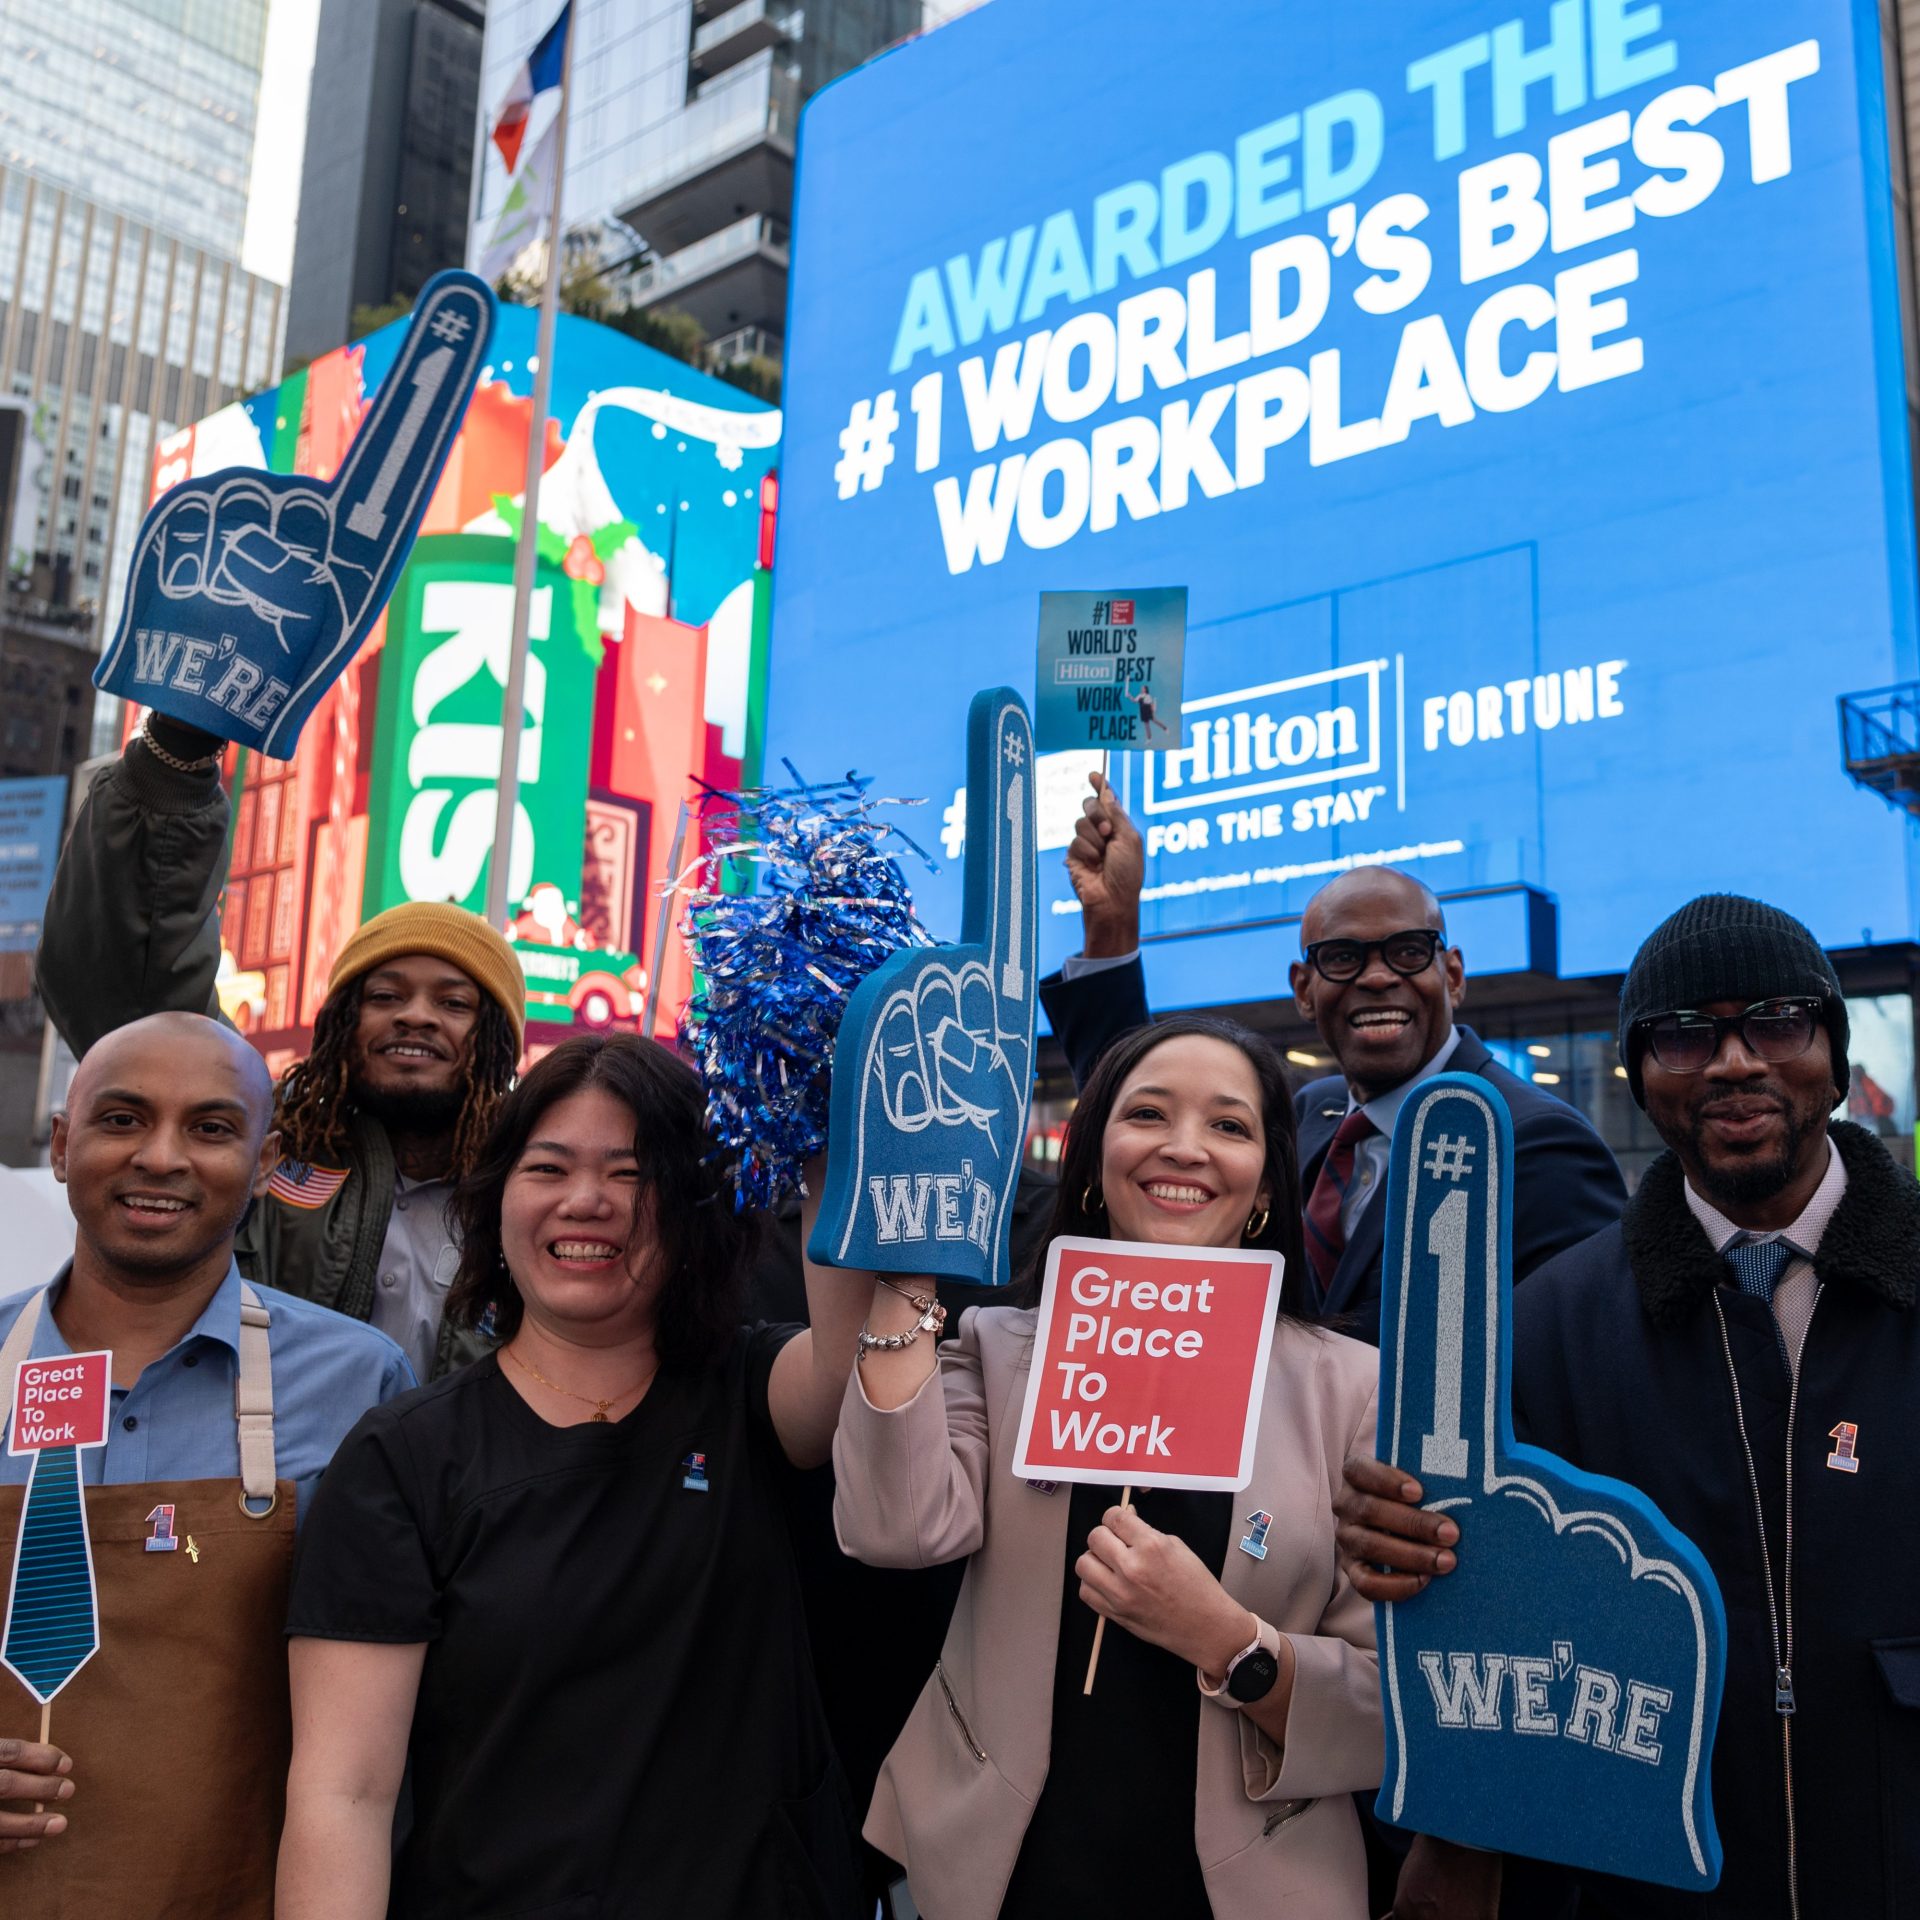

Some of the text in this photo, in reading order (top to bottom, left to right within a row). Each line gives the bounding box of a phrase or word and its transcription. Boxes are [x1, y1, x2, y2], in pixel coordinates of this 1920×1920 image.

[889, 0, 1678, 374] AWARDED THE
[834, 39, 1820, 501] #1 WORLD'S BEST
[934, 248, 1644, 575] WORKPLACE
[1092, 600, 1111, 625] #1
[1068, 629, 1137, 655] WORLD'S
[134, 629, 291, 732] WE'RE
[1060, 657, 1155, 682] Hilton BEST
[1077, 687, 1123, 712] WORK
[1424, 660, 1624, 751] FORTUNE
[1089, 715, 1137, 741] PLACE
[1163, 706, 1359, 789] Hilton
[1147, 787, 1376, 857] FOR THE STAY
[1071, 1266, 1214, 1313] Great
[1065, 1313, 1203, 1358] Place
[25, 1364, 84, 1385] Great
[25, 1386, 82, 1404] Place
[1057, 1362, 1107, 1401] To
[21, 1422, 75, 1444] Work
[22, 1407, 45, 1423] To
[1050, 1410, 1176, 1456] Work
